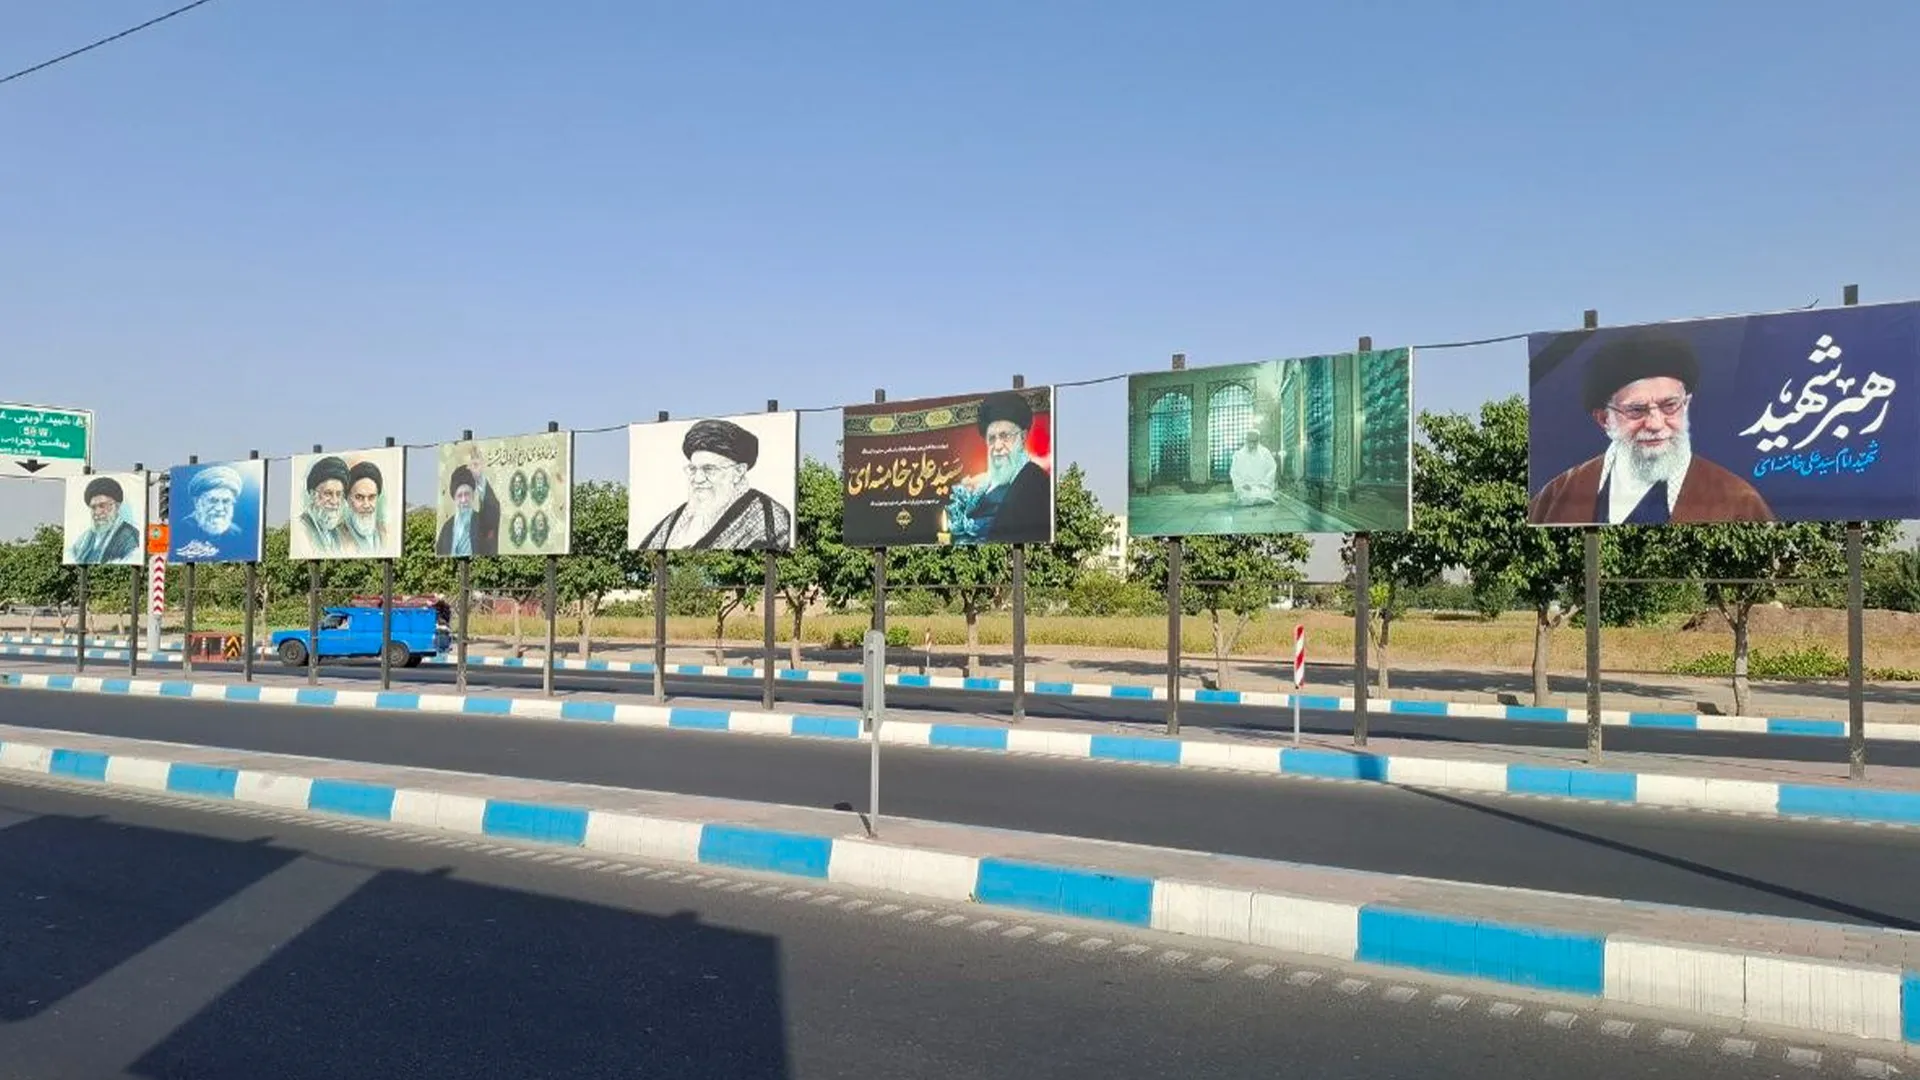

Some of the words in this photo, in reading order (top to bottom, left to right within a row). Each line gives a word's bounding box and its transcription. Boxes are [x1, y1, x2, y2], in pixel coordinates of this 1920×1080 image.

[1738, 334, 1843, 453] شهید
[1793, 371, 1896, 450] رهبر
[37, 437, 71, 451] بهشت
